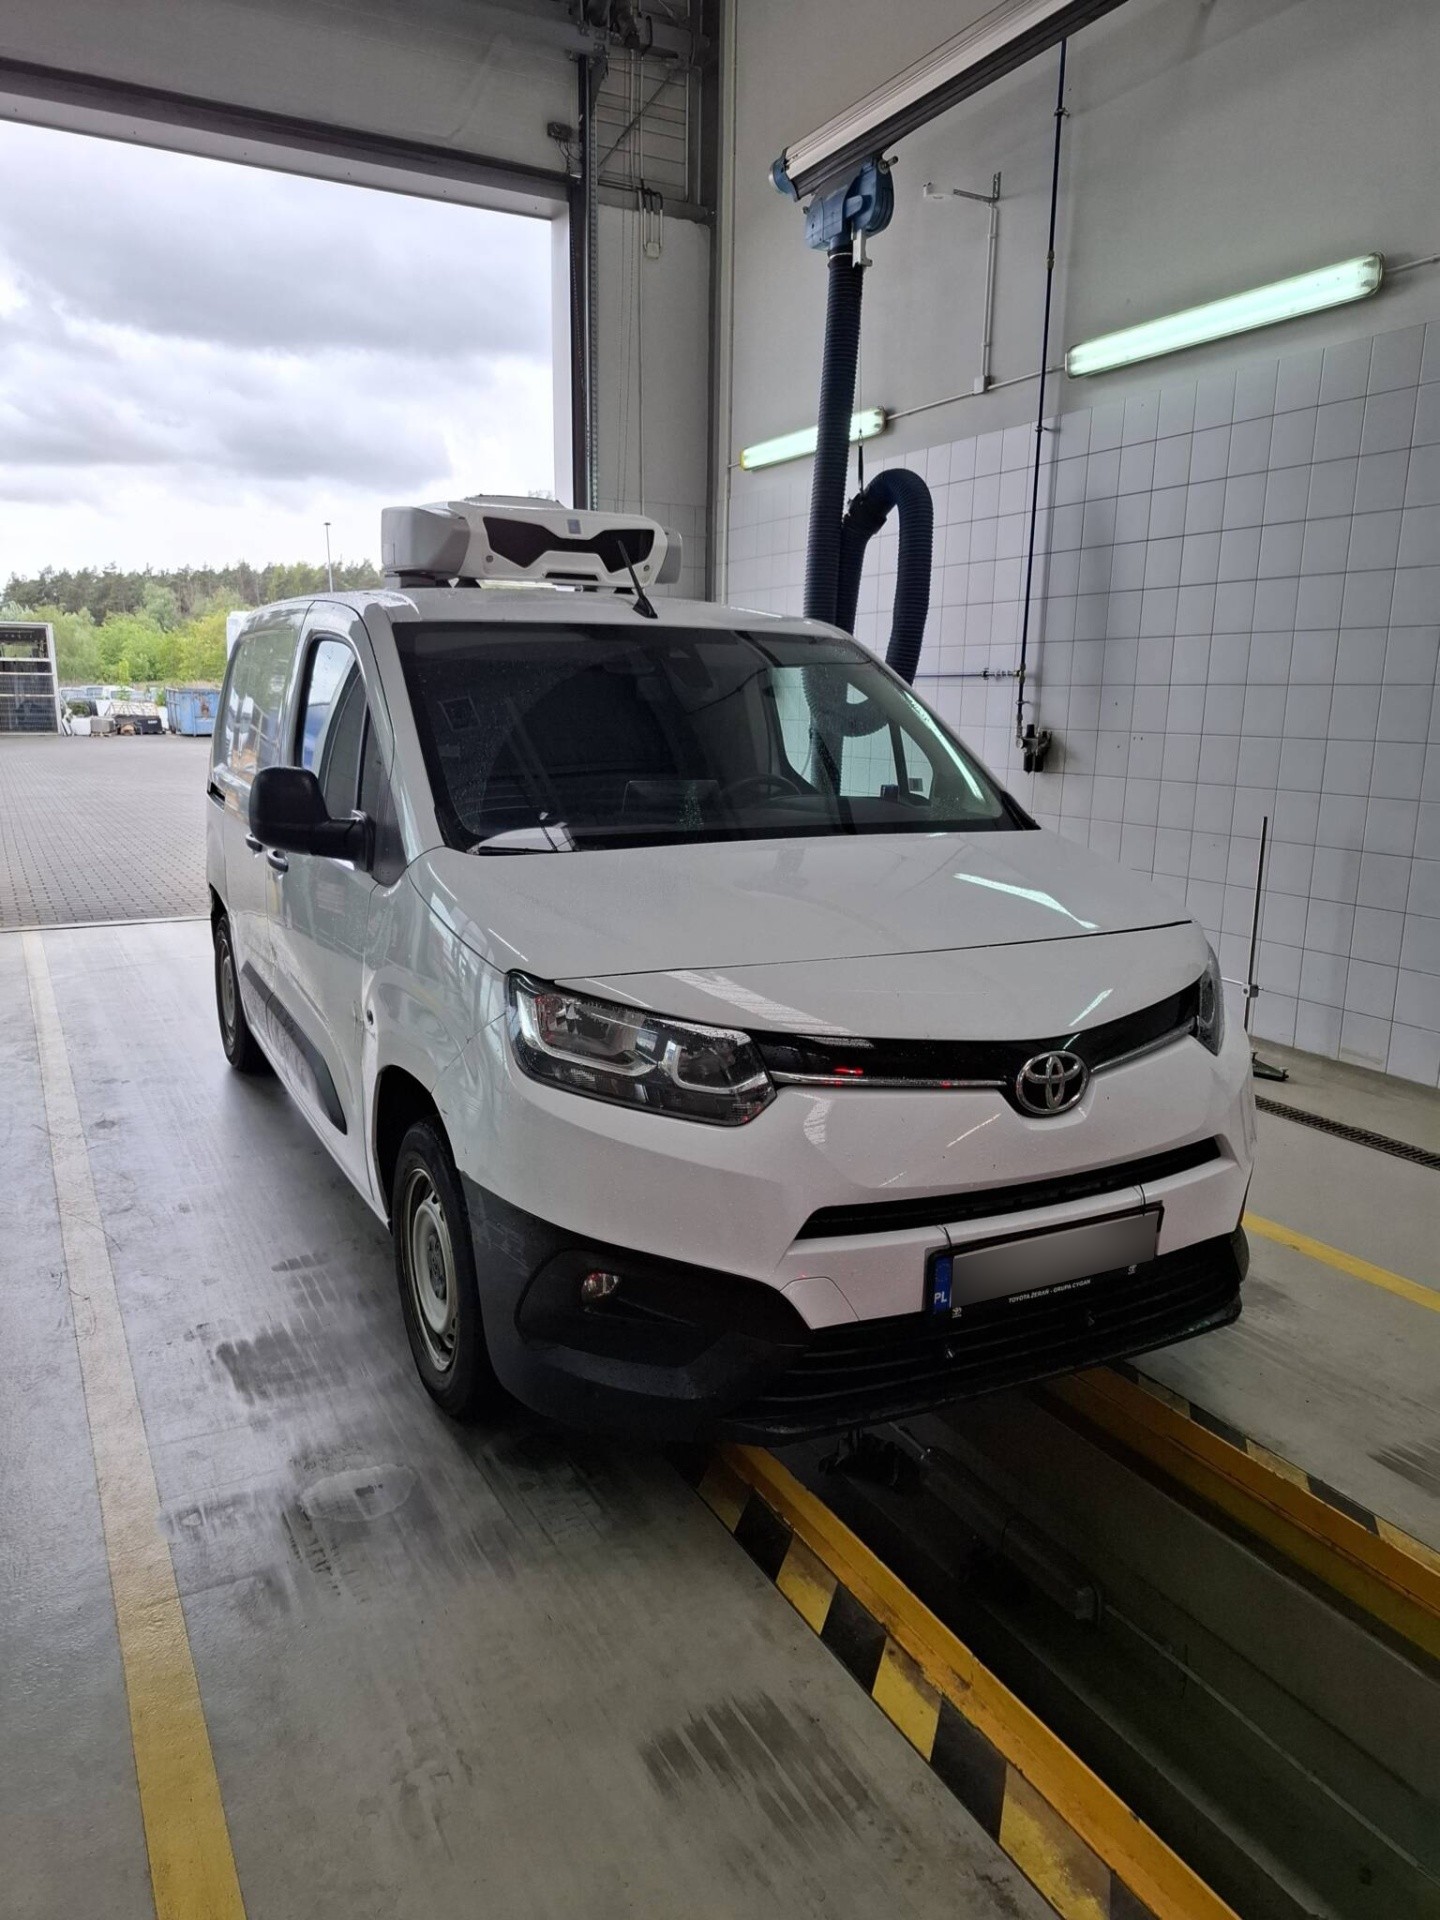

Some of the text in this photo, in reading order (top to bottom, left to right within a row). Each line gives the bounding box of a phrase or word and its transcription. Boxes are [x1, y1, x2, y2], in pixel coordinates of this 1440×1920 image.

[934, 1291, 947, 1304] PL
[1009, 1293, 1030, 1303] TOYOTA
[1053, 1284, 1072, 1293] GRUPA
